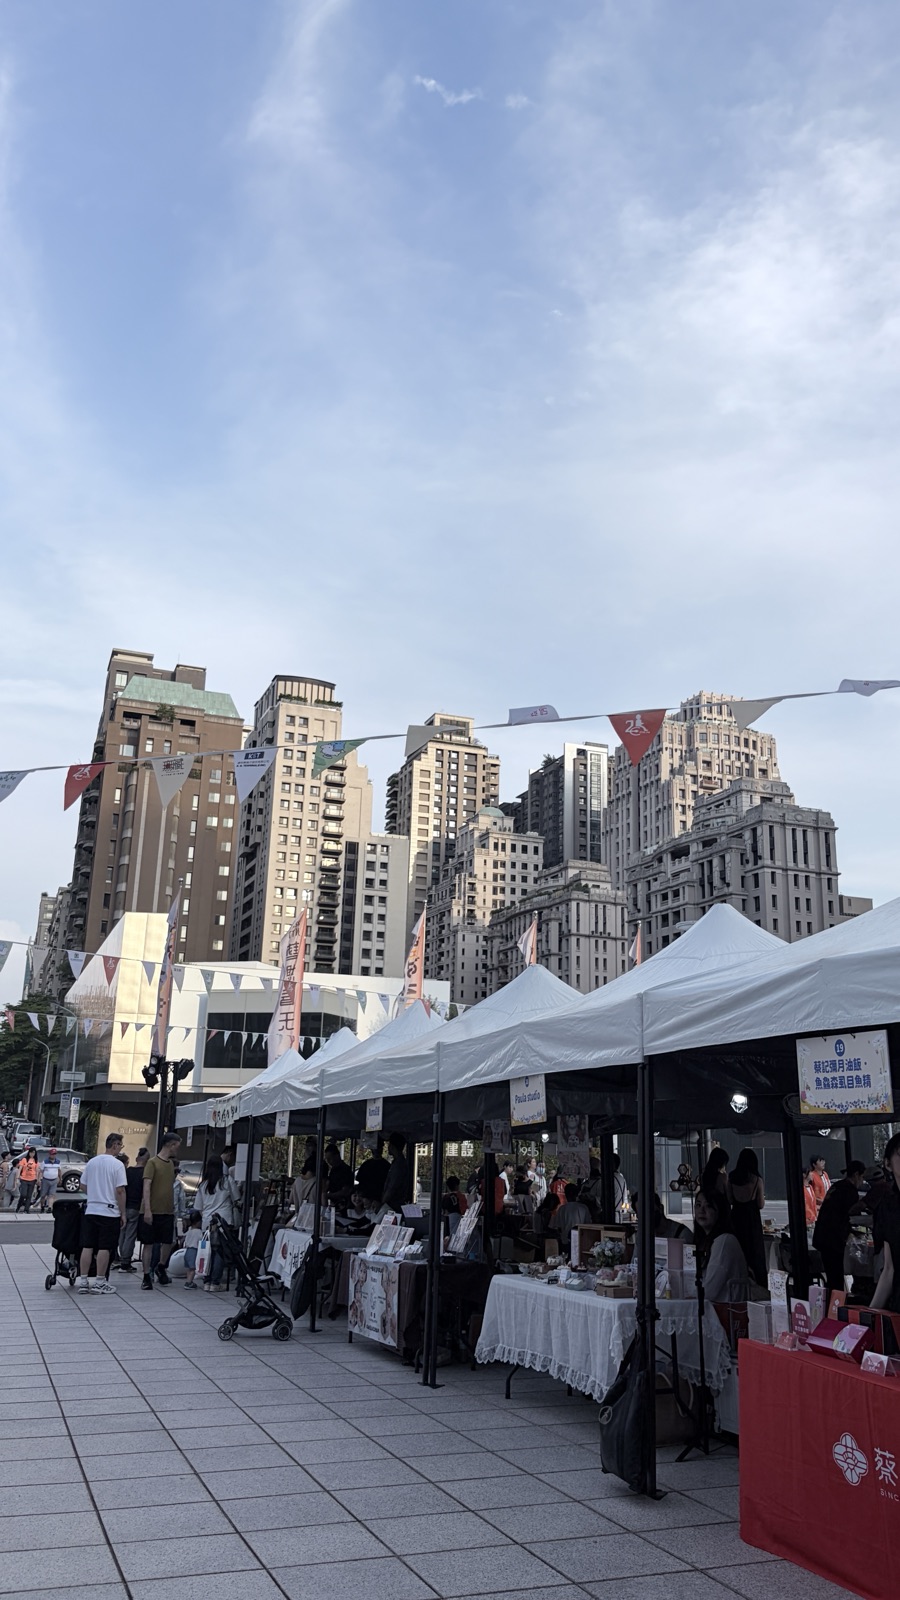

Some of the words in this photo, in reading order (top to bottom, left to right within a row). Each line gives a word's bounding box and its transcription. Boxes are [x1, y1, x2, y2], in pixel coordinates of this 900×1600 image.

[836, 1043, 844, 1053] 19
[515, 1093, 527, 1104] Paula
[527, 1090, 540, 1101] studio
[874, 1447, 898, 1486] 蔡
